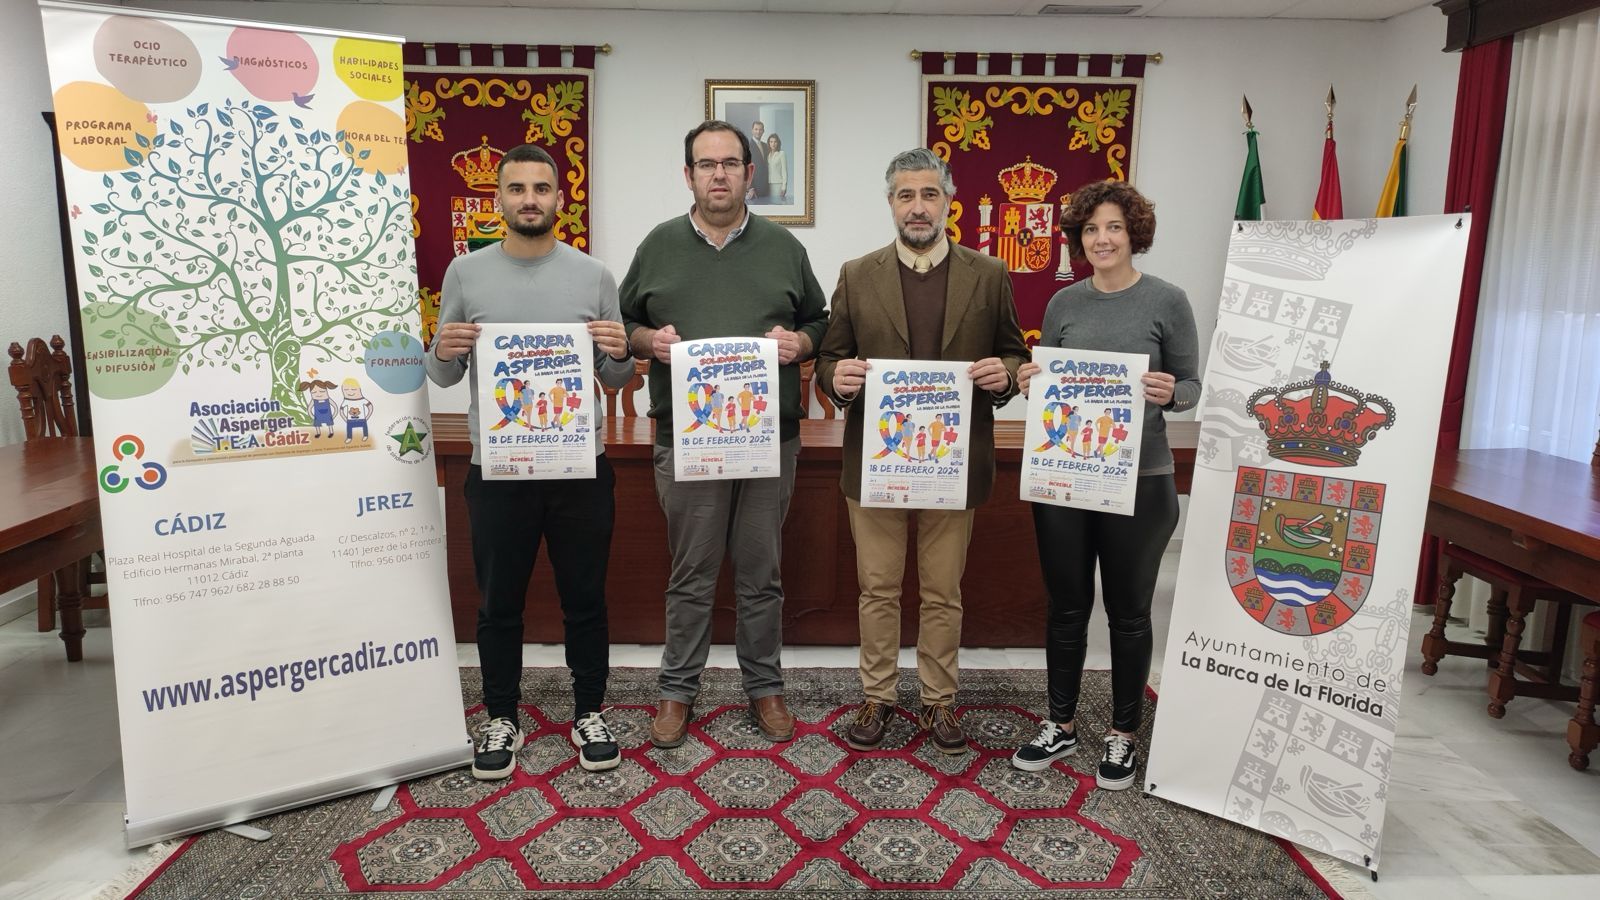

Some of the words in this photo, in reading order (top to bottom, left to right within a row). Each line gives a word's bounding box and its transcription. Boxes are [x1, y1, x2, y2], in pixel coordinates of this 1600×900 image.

[133, 40, 160, 51] OCIO
[109, 53, 187, 68] TERAPÉUTICO
[233, 55, 308, 70] DIAGNÓSTICOS
[339, 56, 399, 71] HABILIDADES
[350, 71, 392, 84] SOCIALES
[66, 120, 132, 132] PROGRAMA
[73, 135, 128, 146] LABORAL
[374, 134, 391, 143] DEL
[494, 334, 574, 350] CARRERA
[688, 341, 760, 357] CARRERA
[84, 345, 170, 360] ENSIBILIZACIÓN
[105, 361, 156, 373] DIFUSIÓN
[371, 355, 423, 368] FORMACIÓN
[494, 354, 581, 377] ASPERGER
[1050, 359, 1128, 378] CARRERA
[687, 359, 767, 382] ASPERGER
[882, 371, 956, 386] CARRERA
[1045, 384, 1132, 400] ASPERGER
[190, 397, 281, 417] Asociación
[879, 391, 960, 410] ASPERGER
[220, 415, 294, 433] Asperger
[488, 435, 497, 444] 18
[500, 435, 513, 444] DE
[516, 434, 559, 445] FEBRERO
[562, 434, 586, 443] 2024
[682, 437, 689, 446] 18
[692, 437, 704, 445] DE
[707, 435, 747, 445] FEBRERO
[749, 435, 771, 444] 2024
[869, 464, 877, 472] 18
[880, 465, 891, 473] DE
[894, 465, 934, 475] FEBRERO
[937, 466, 959, 475] 2024
[1031, 457, 1039, 465] 18
[1041, 458, 1054, 467] DE
[1057, 460, 1101, 473] FEBRERO
[1102, 466, 1128, 476] 2024
[356, 492, 414, 517] JEREZ
[154, 512, 227, 536] CÁDIZ
[338, 535, 348, 545] C/
[351, 530, 397, 543] Descalzos,
[108, 556, 135, 567] Plaza
[138, 552, 161, 563] Real
[163, 546, 206, 562] Hospital
[208, 544, 221, 554] de
[223, 542, 233, 552] la
[235, 537, 278, 552] Segunda
[280, 533, 315, 548] Aguada
[332, 547, 359, 558] 11401
[361, 545, 384, 556] Jerez
[386, 542, 398, 552] de
[410, 537, 441, 549] Frontera
[123, 567, 161, 580] Edificio
[164, 560, 217, 575] Hermanas
[220, 554, 260, 569] Mirabal,
[274, 549, 304, 563] planta
[376, 555, 394, 566] 956
[396, 552, 413, 563] 004
[415, 550, 431, 561] 105
[188, 574, 219, 586] 11012
[221, 569, 249, 582] Cádiz
[165, 592, 186, 603] 956
[189, 589, 208, 600] 747
[211, 584, 234, 598] 962/
[236, 582, 255, 593] 682
[258, 579, 270, 590] 28
[272, 577, 285, 588] 88
[287, 575, 300, 586] 50
[1185, 631, 1345, 682] Ayuntamiento
[1357, 672, 1387, 693] de
[142, 636, 440, 712] www.aspergercadiz.com
[1181, 651, 1201, 669] La
[1206, 657, 1259, 684] Barca
[1264, 673, 1289, 691] de
[1294, 679, 1312, 698] la
[1318, 685, 1383, 717] Florida
